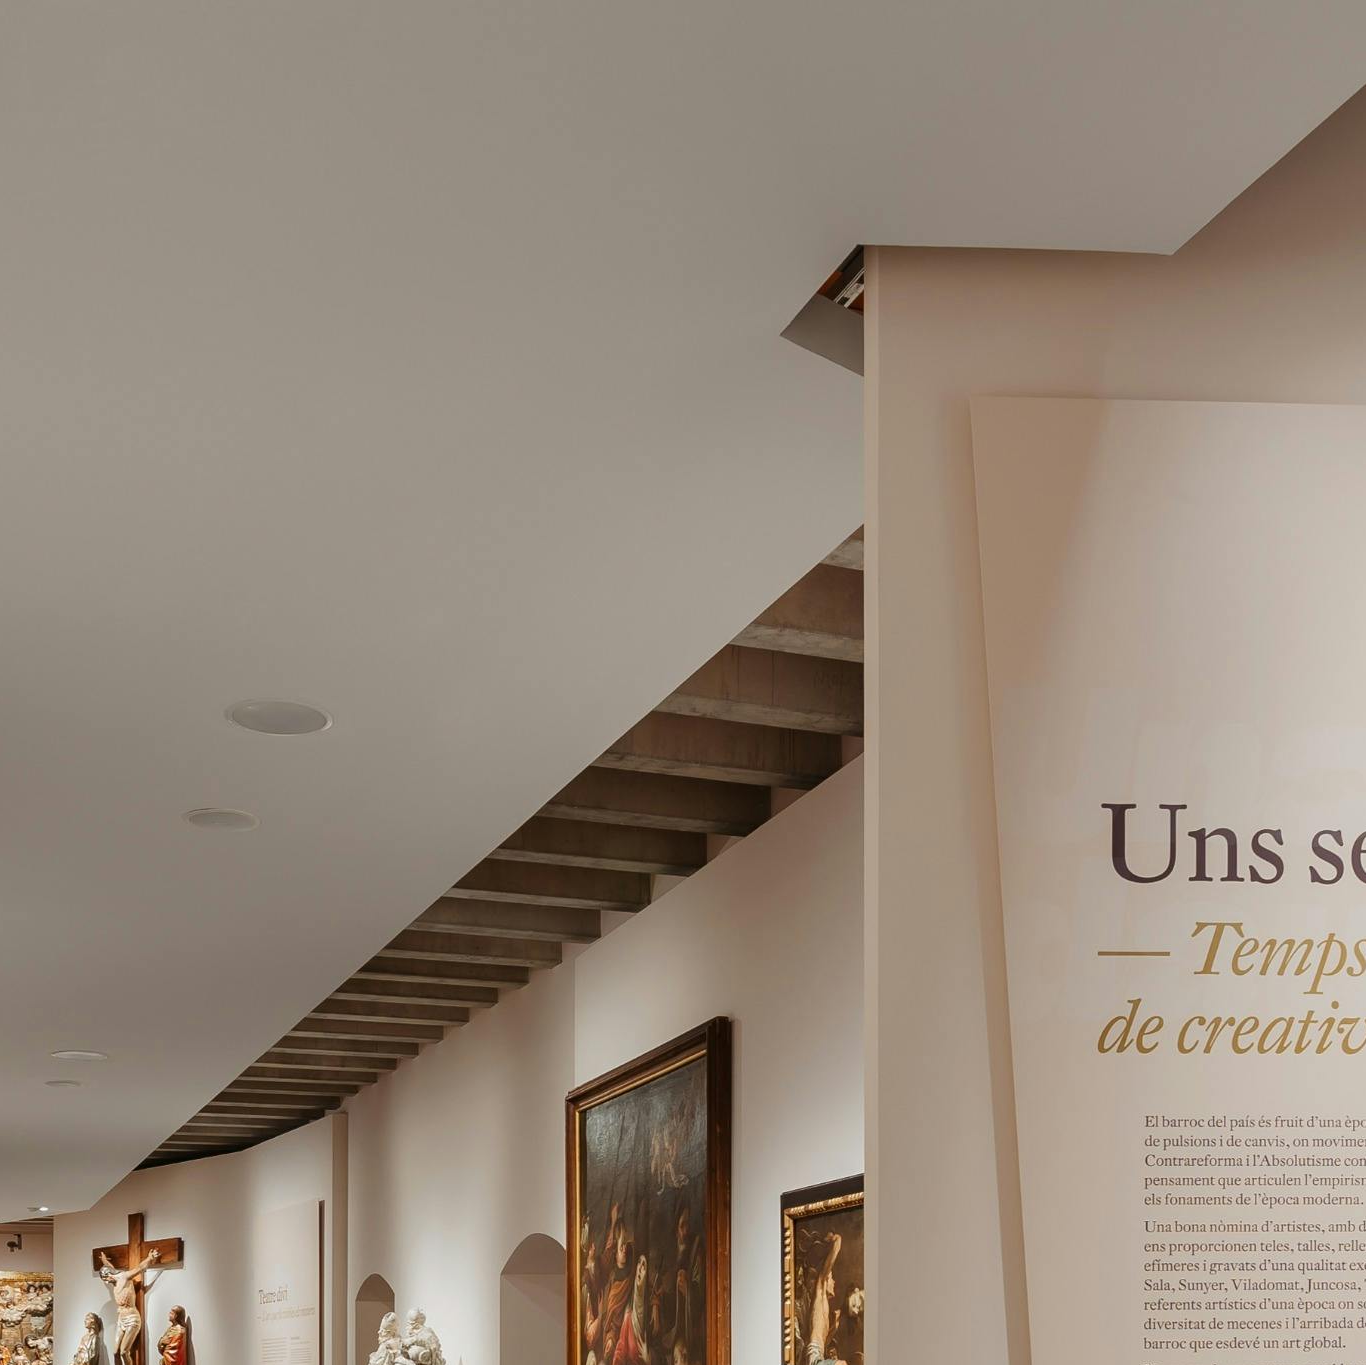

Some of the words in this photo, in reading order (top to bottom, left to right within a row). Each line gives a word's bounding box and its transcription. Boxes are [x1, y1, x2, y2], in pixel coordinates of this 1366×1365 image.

[1100, 802, 1284, 884] Uns
[1097, 998, 1164, 1054] de
[1145, 1115, 1158, 1128] El
[1160, 1115, 1205, 1128] barroc
[1206, 1115, 1228, 1128] del
[1230, 1115, 1256, 1132] país
[1258, 1115, 1273, 1128] és
[1274, 1115, 1305, 1128] fruit
[1306, 1115, 1342, 1128] d’una
[1144, 1134, 1161, 1147] de
[1163, 1134, 1217, 1151] pulsions
[1226, 1134, 1243, 1147] de
[1245, 1135, 1291, 1149] canvis,
[1292, 1138, 1310, 1147] on
[1145, 1154, 1243, 1167] Contrareforma
[1252, 1154, 1341, 1167] l’Absolutisme
[1144, 1174, 1216, 1190] pensament
[1218, 1177, 1242, 1190] que
[1244, 1173, 1302, 1186] articulen
[1144, 1192, 1162, 1205] els
[1164, 1192, 1234, 1205] fonaments
[1235, 1192, 1251, 1205] de
[1253, 1192, 1300, 1209] l’època
[1302, 1192, 1364, 1205] moderna.
